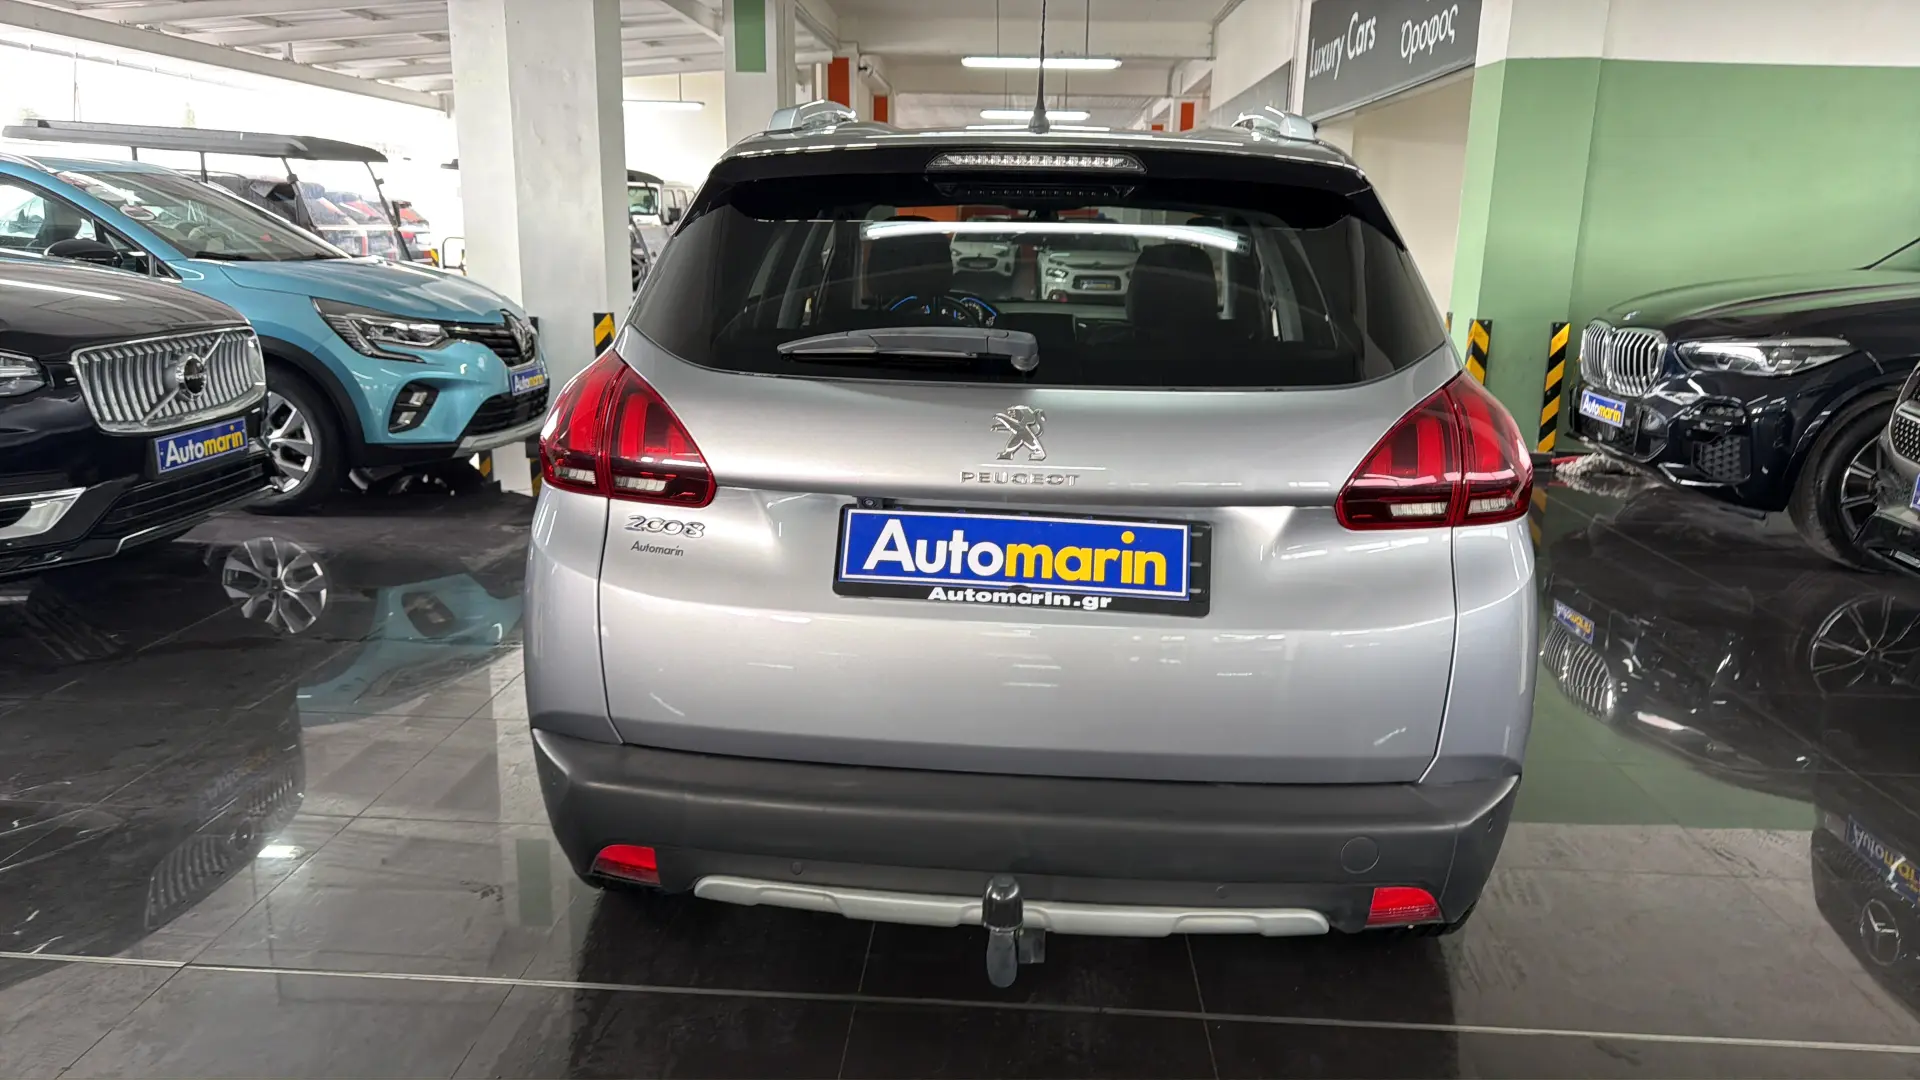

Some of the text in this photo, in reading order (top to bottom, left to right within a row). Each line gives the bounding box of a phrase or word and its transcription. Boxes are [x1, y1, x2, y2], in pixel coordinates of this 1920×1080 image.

[1309, 11, 1377, 80] Luxury Cars
[166, 425, 244, 467] Automarin
[960, 471, 1080, 486] PEUGEOT
[624, 514, 706, 538] 2008
[630, 540, 684, 556] Automarin
[862, 518, 1167, 586] Automarin
[928, 587, 1112, 611] Automarin.gr
